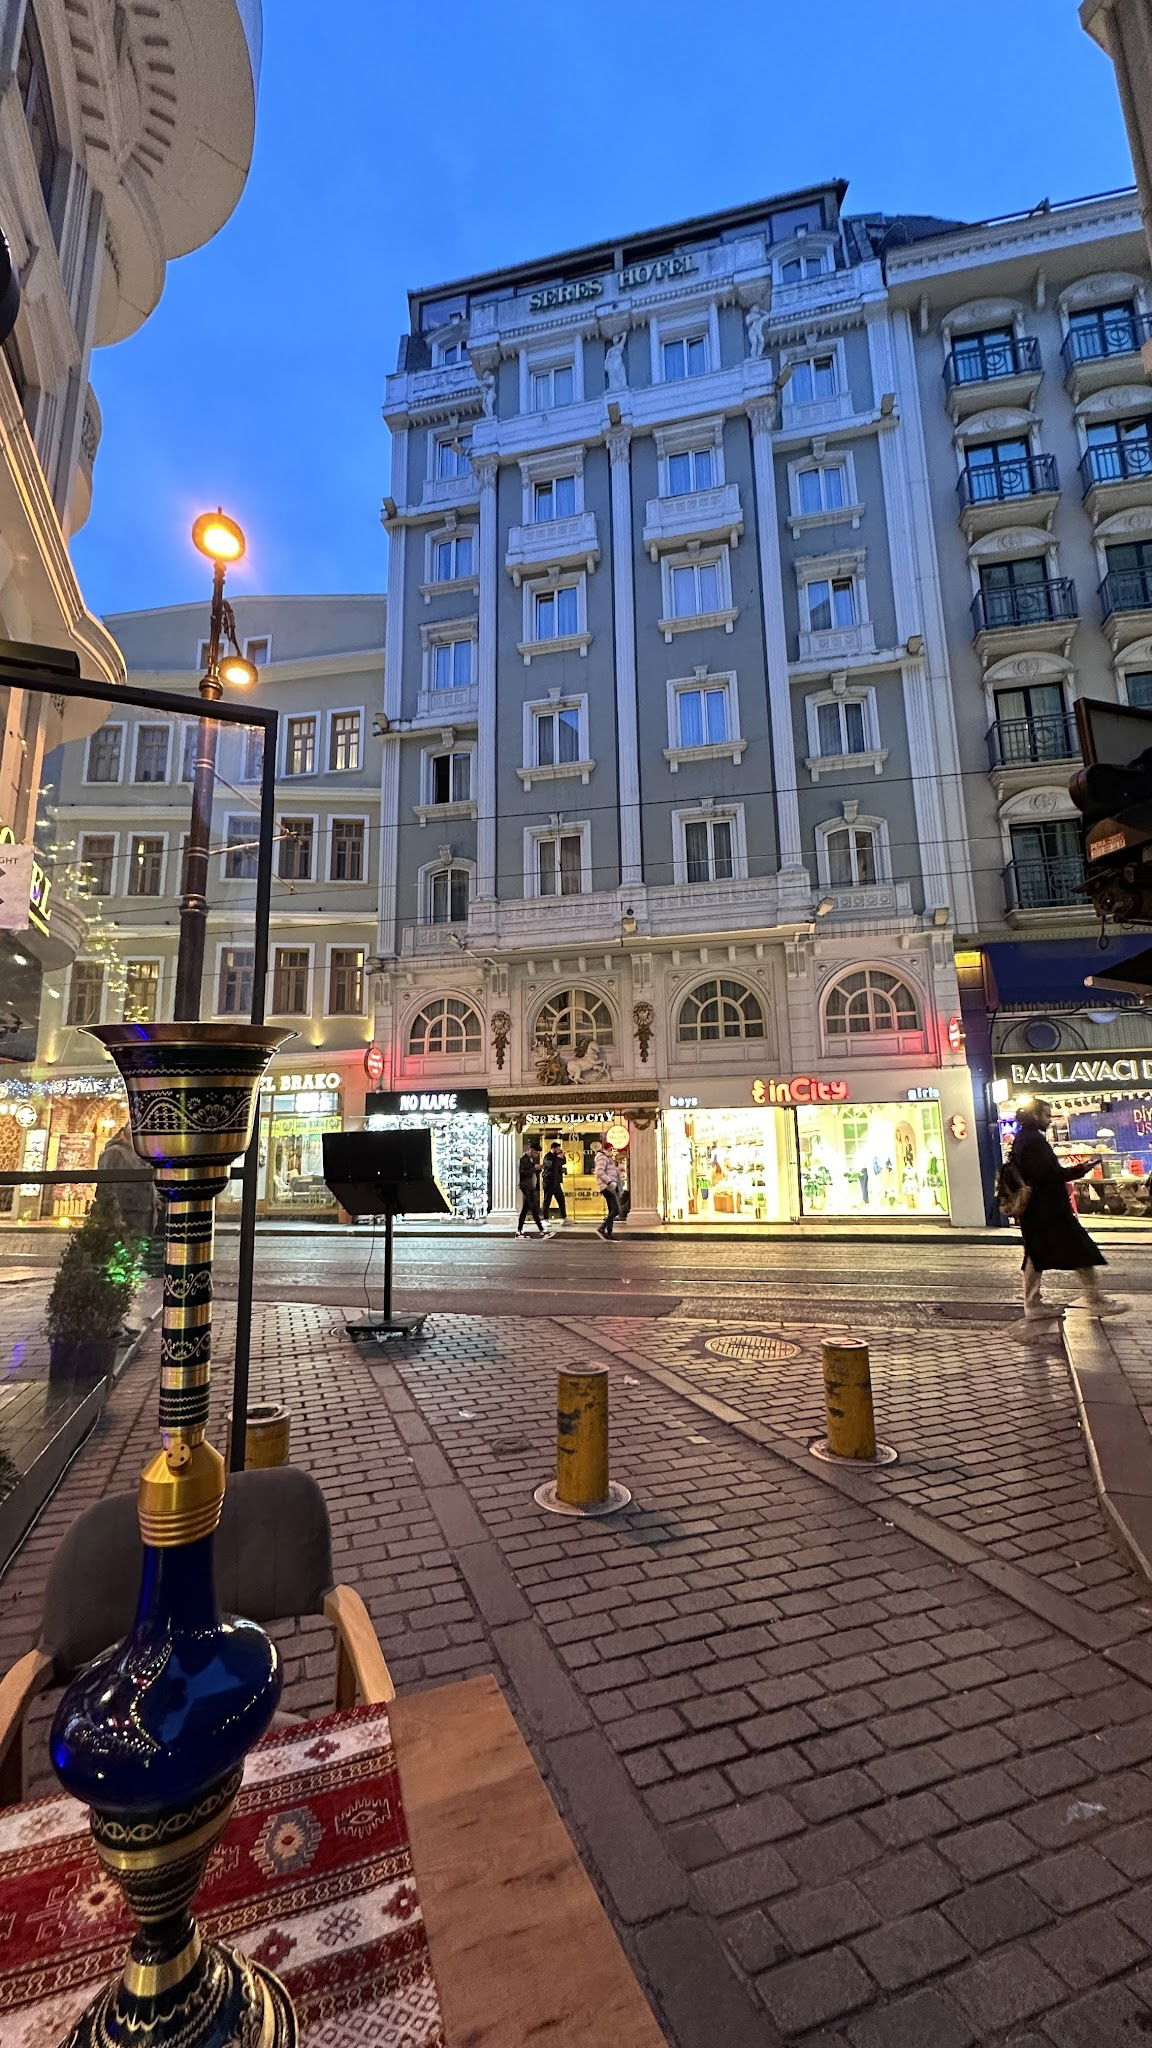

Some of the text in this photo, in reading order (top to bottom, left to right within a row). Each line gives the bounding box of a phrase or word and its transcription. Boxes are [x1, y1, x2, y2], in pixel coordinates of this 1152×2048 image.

[530, 255, 699, 311] SERES HOTEL
[1011, 1059, 1138, 1084] BAKLAVACI
[280, 1072, 341, 1091] BRAKO
[769, 1078, 847, 1102] inCity
[399, 1093, 457, 1111] NO NAME
[669, 1095, 698, 1108] boys
[907, 1086, 940, 1101] girls
[526, 1113, 561, 1124] SERES
[562, 1113, 585, 1124] OLD
